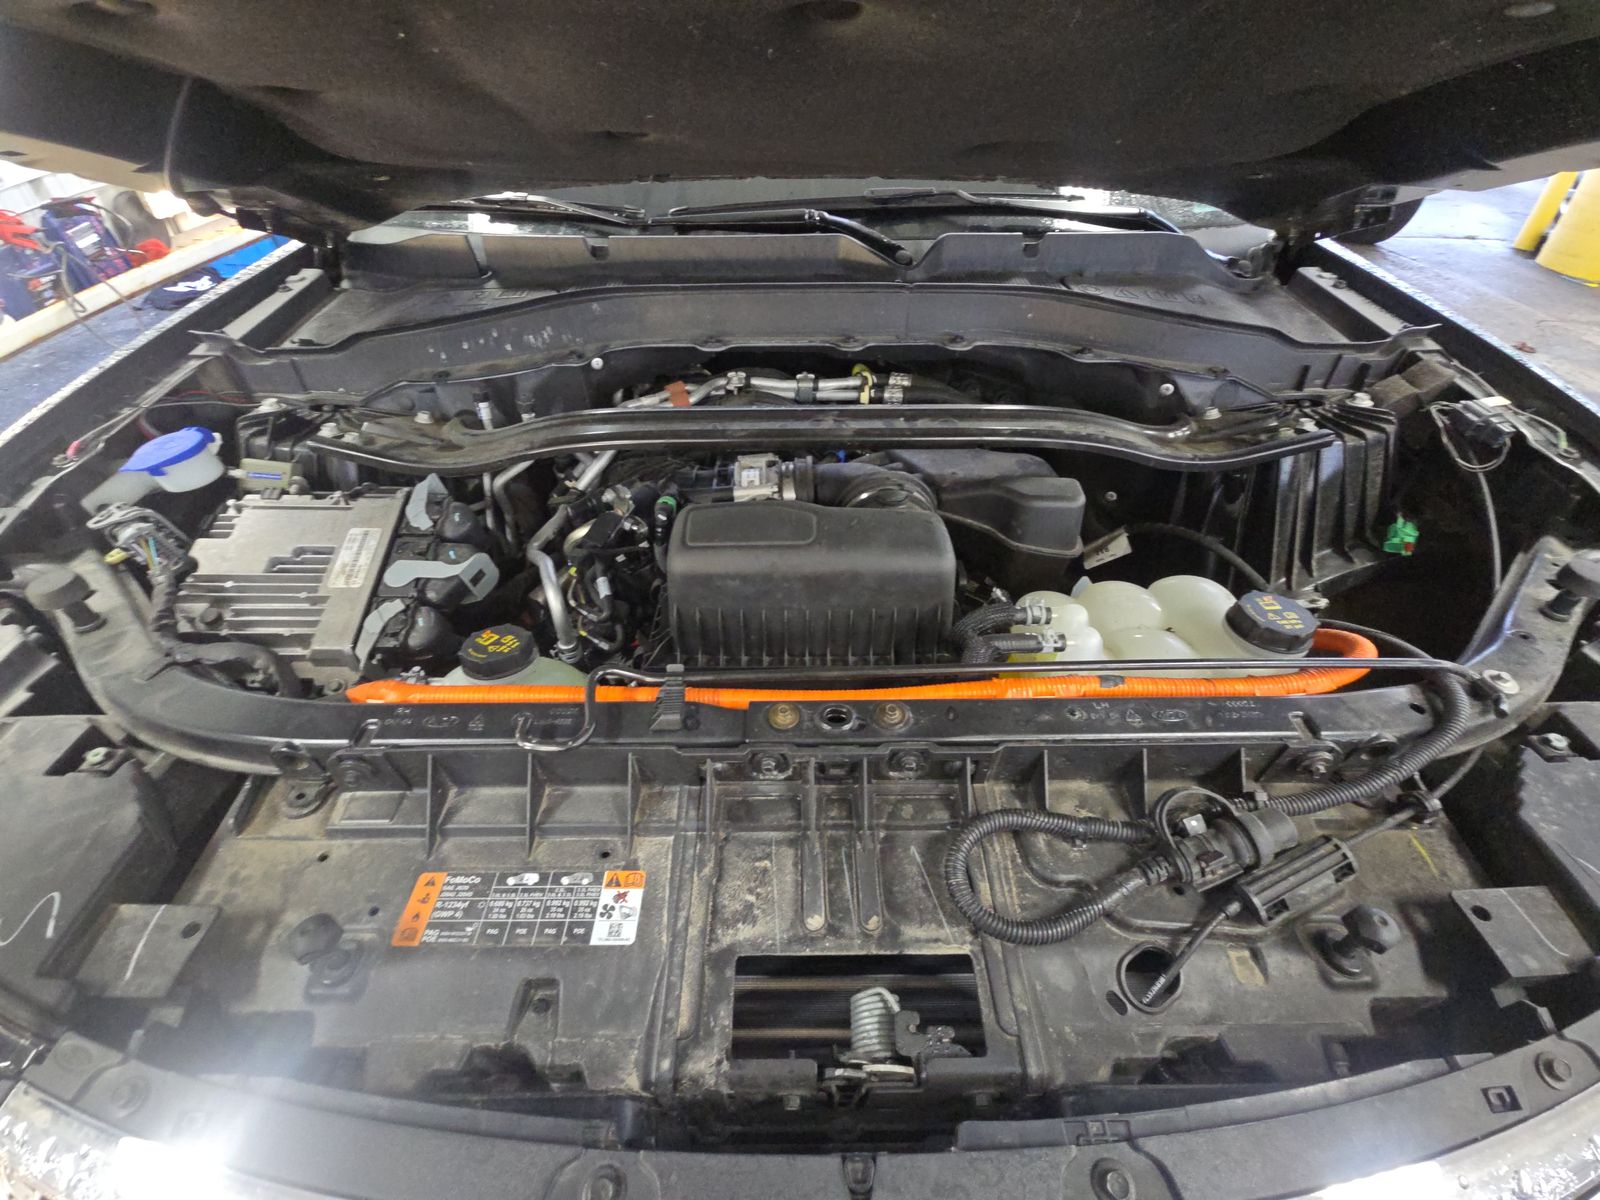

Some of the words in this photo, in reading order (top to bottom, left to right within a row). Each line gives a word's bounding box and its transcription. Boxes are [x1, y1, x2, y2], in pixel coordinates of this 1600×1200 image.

[444, 875, 482, 884] FoMoCo
[435, 900, 471, 909] R-1234yf
[506, 900, 514, 908] kg
[533, 900, 541, 908] kg
[562, 900, 571, 908] kg
[590, 900, 598, 908] kg
[431, 910, 455, 920] (GWP
[455, 910, 464, 919] 4)
[423, 928, 440, 936] PAG
